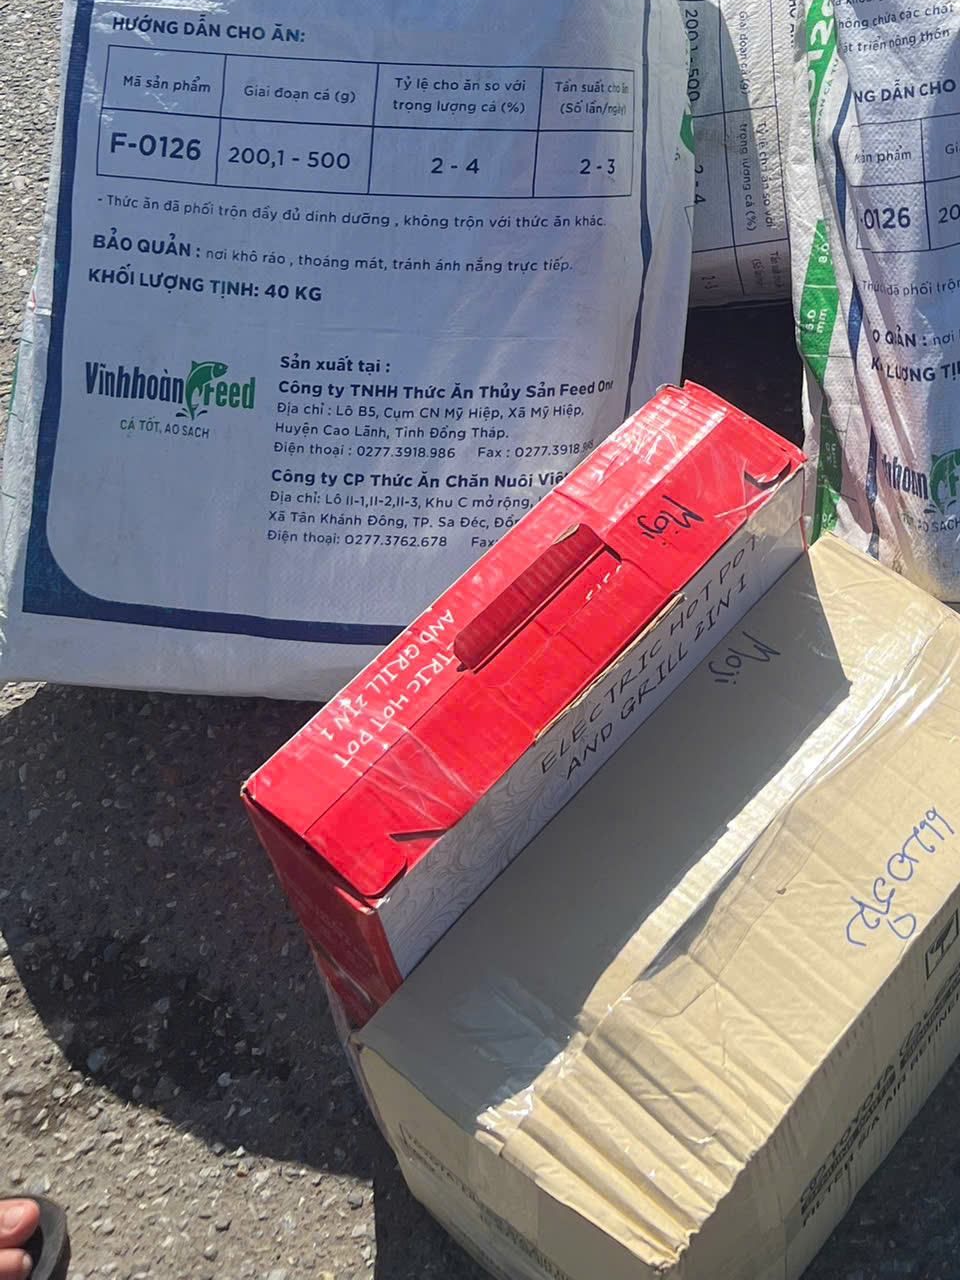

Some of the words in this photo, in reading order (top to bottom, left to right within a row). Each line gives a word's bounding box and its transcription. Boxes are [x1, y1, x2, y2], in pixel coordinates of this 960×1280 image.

[112, 16, 179, 35] HƯỚNG
[183, 14, 221, 37] DẪN
[226, 24, 266, 42] CHO
[271, 22, 306, 43] ĂN:
[123, 75, 141, 88] Mã
[145, 75, 169, 90] sản
[172, 74, 211, 94] phẩm
[243, 84, 271, 99] Giai
[274, 87, 310, 103] đoạn
[313, 88, 330, 101] cá
[334, 90, 356, 104] (g)
[880, 79, 915, 102] DẪN
[919, 78, 956, 97] CHO
[392, 98, 433, 115] trọng
[436, 99, 477, 114] lượng
[480, 100, 497, 113] cá
[500, 101, 526, 114] (%)
[109, 131, 202, 161] F-0126
[228, 146, 285, 169] 200,1
[307, 151, 351, 170] 500
[430, 157, 443, 175] 2
[466, 157, 480, 175] 4
[580, 158, 591, 175] 2
[607, 158, 616, 175] 3
[107, 194, 138, 209] Thức
[142, 195, 159, 210] ăn
[163, 198, 180, 213] đã
[184, 200, 214, 218] phối
[218, 204, 248, 221] trộn
[251, 204, 278, 222] đầy
[282, 206, 301, 221] đủ
[305, 209, 337, 224] dinh
[341, 211, 390, 228] dưỡng
[403, 212, 449, 229] không
[454, 212, 484, 229] trộn
[489, 213, 511, 228] với
[516, 212, 549, 228] thức
[553, 211, 571, 227] ăn
[575, 210, 607, 227] khác.
[92, 227, 133, 252] BẢO
[137, 233, 192, 257] QUẢN
[206, 248, 228, 260] nơi
[232, 249, 258, 263] khô
[262, 251, 286, 265] ráo
[298, 253, 350, 270] thoáng
[354, 255, 388, 271] mát,
[392, 257, 431, 271] tránh
[435, 258, 460, 271] ánh
[465, 256, 503, 274] nắng
[507, 257, 538, 272] trực
[543, 255, 574, 273] tiếp.
[88, 263, 135, 286] KHỐI
[139, 270, 204, 294] LƯỢNG
[209, 278, 260, 298] TỊNH:
[264, 283, 290, 299] 40
[295, 285, 323, 302] KG
[280, 354, 311, 371] Sản
[315, 355, 353, 373] xuất
[357, 358, 381, 374] tại
[278, 379, 323, 399] Công
[327, 384, 344, 399] ty
[350, 384, 399, 398] TNHH
[403, 382, 446, 400] Thức
[450, 381, 474, 400] Ăn
[479, 380, 521, 401] Thủy
[525, 379, 556, 399] Sản
[559, 382, 596, 398] Feed
[120, 417, 135, 431] CÁ
[164, 423, 180, 435] AO
[274, 441, 305, 456] Điện
[309, 442, 345, 457] thoại
[356, 445, 456, 459] 0277.3918.986
[477, 446, 502, 459] Fax
[344, 534, 448, 548] 0277.3762.678
[670, 580, 712, 636] HOT
[719, 535, 756, 585] POT
[419, 609, 455, 644] AND
[364, 643, 420, 693] GRILL
[406, 641, 457, 693] TRIC
[370, 694, 409, 732] HOT
[566, 722, 613, 780] AND
[620, 642, 689, 721] GRILL
[333, 729, 374, 768] POT
